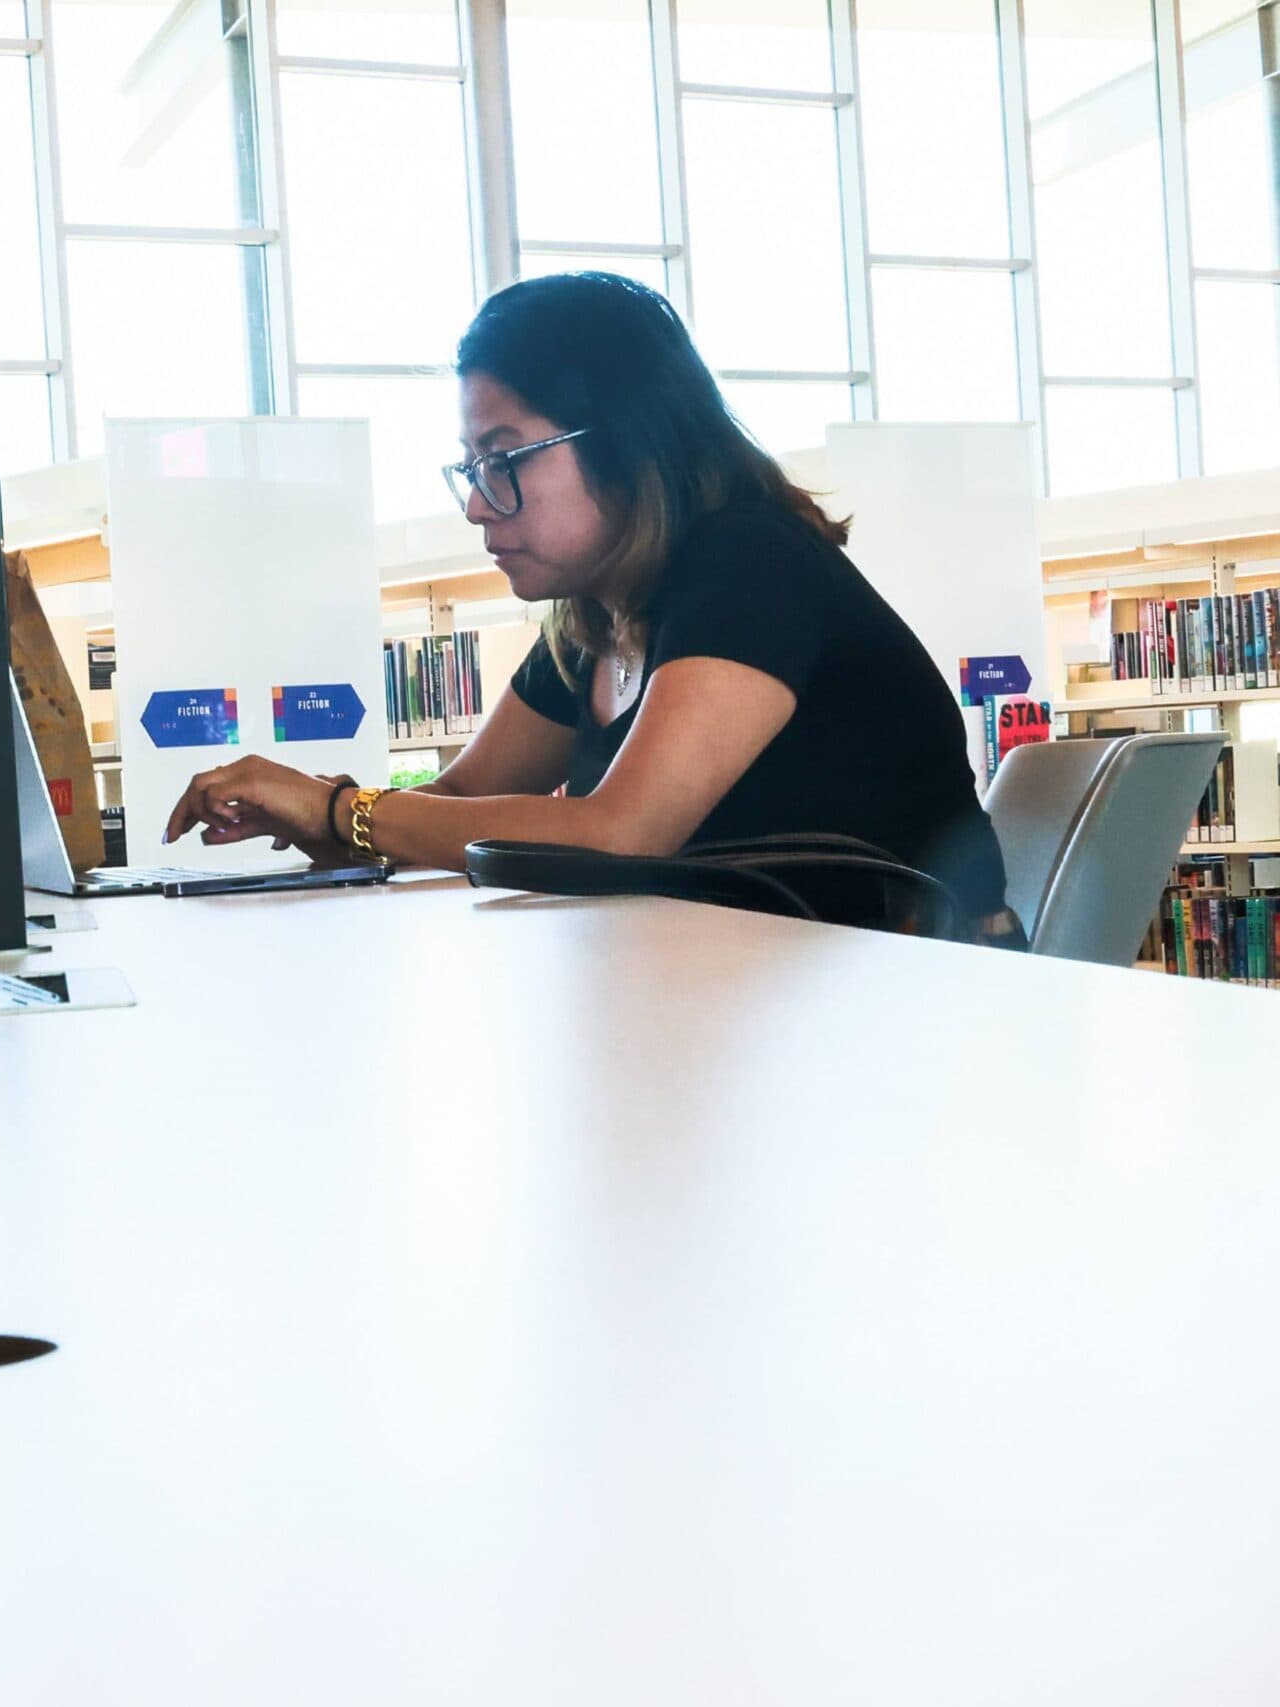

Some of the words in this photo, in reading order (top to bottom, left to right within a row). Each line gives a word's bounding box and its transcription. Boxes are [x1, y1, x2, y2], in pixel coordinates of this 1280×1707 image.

[979, 670, 1004, 679] FICTION
[298, 699, 330, 710] FICTION
[177, 706, 210, 717] FICTION
[1000, 701, 1052, 728] STAR
